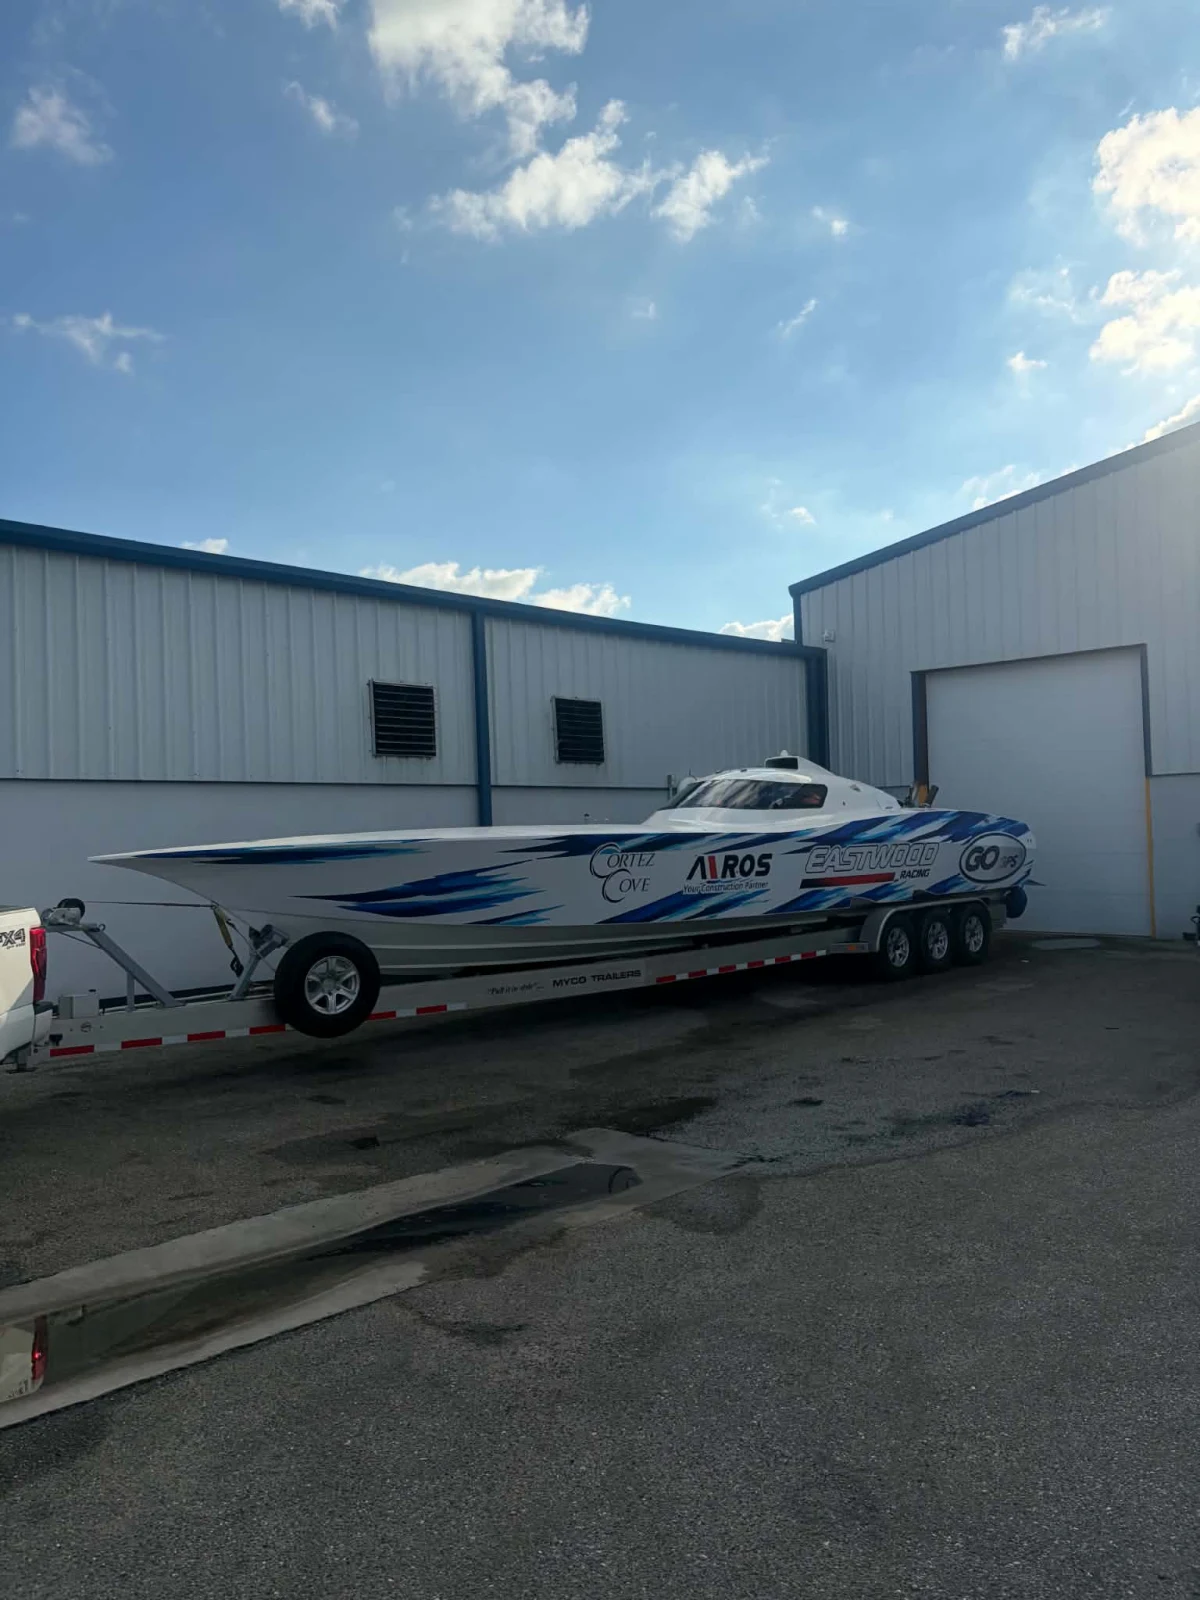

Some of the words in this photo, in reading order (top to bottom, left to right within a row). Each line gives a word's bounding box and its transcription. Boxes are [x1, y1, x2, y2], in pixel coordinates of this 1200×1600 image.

[590, 842, 656, 878] CORTEZ
[805, 842, 940, 874] EASTWOOD
[965, 845, 1000, 873] GO
[602, 869, 651, 904] COVE
[683, 884, 701, 894] Your
[701, 881, 744, 893] Construction
[745, 880, 769, 890] Partner
[900, 868, 931, 880] RACING
[552, 975, 587, 989] MYCO
[591, 969, 642, 983] TRAILERS
